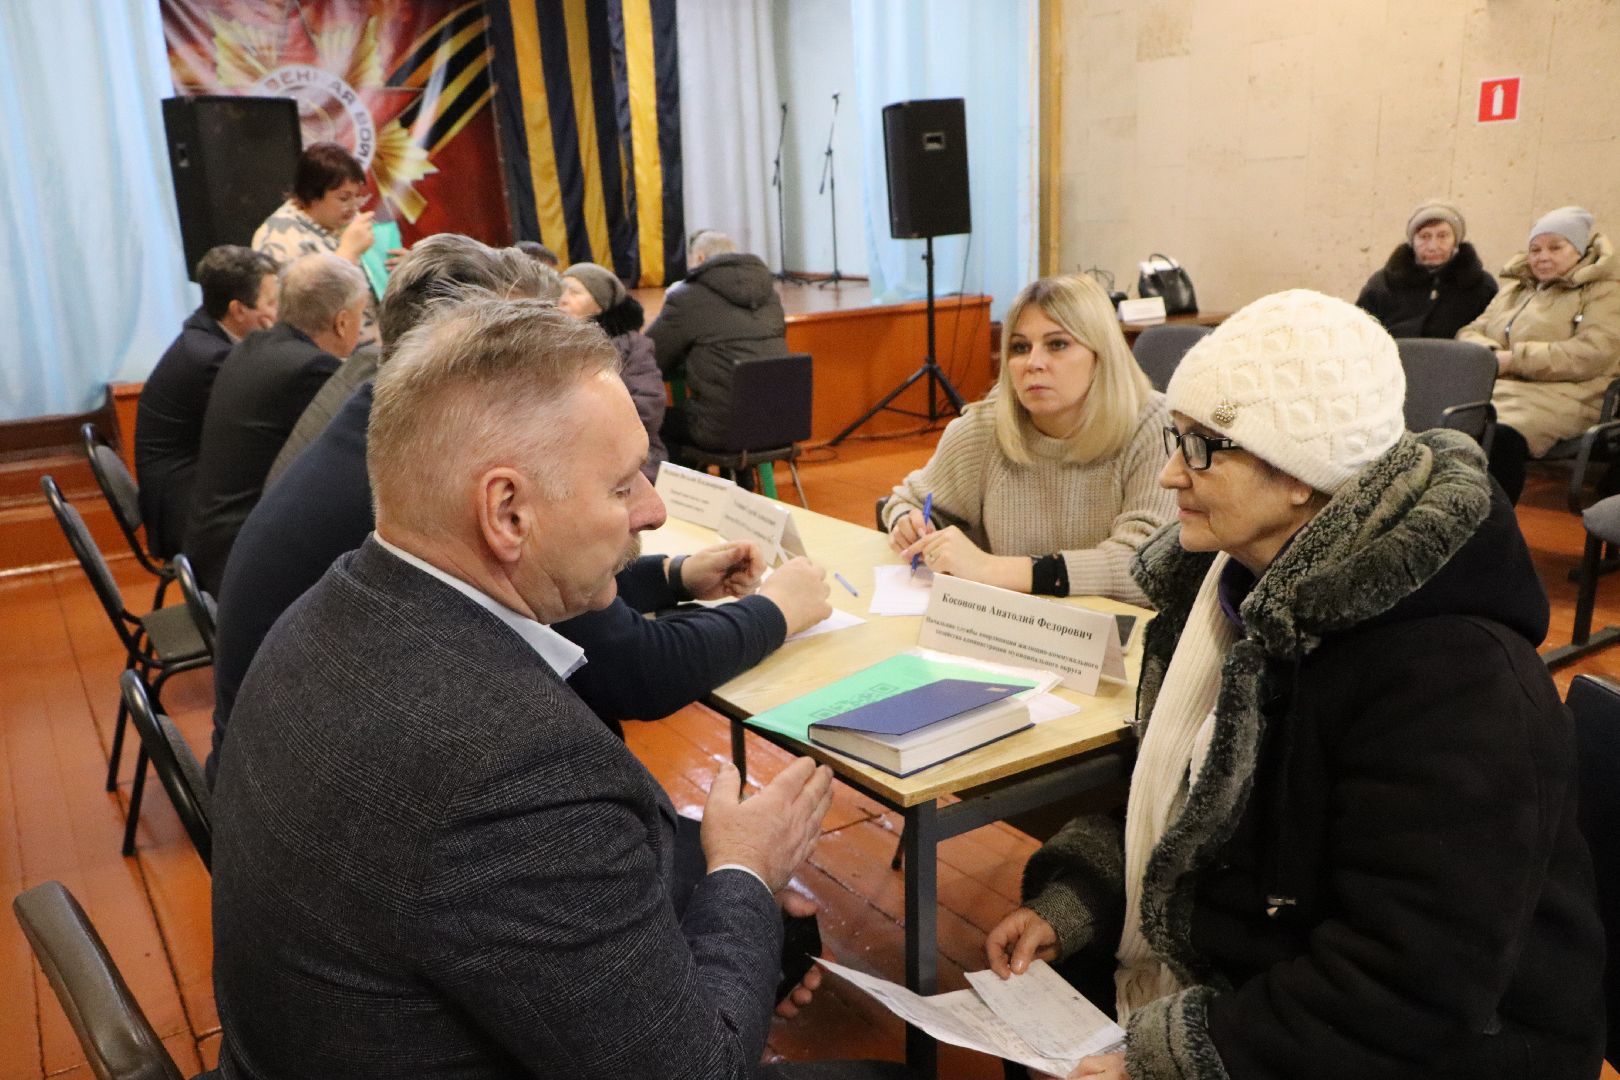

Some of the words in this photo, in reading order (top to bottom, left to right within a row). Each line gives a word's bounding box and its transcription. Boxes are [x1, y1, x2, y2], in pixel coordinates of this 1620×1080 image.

[989, 605, 1035, 626] Анатолий
[1037, 617, 1093, 641] Федорович
[1060, 665, 1082, 676] округа
